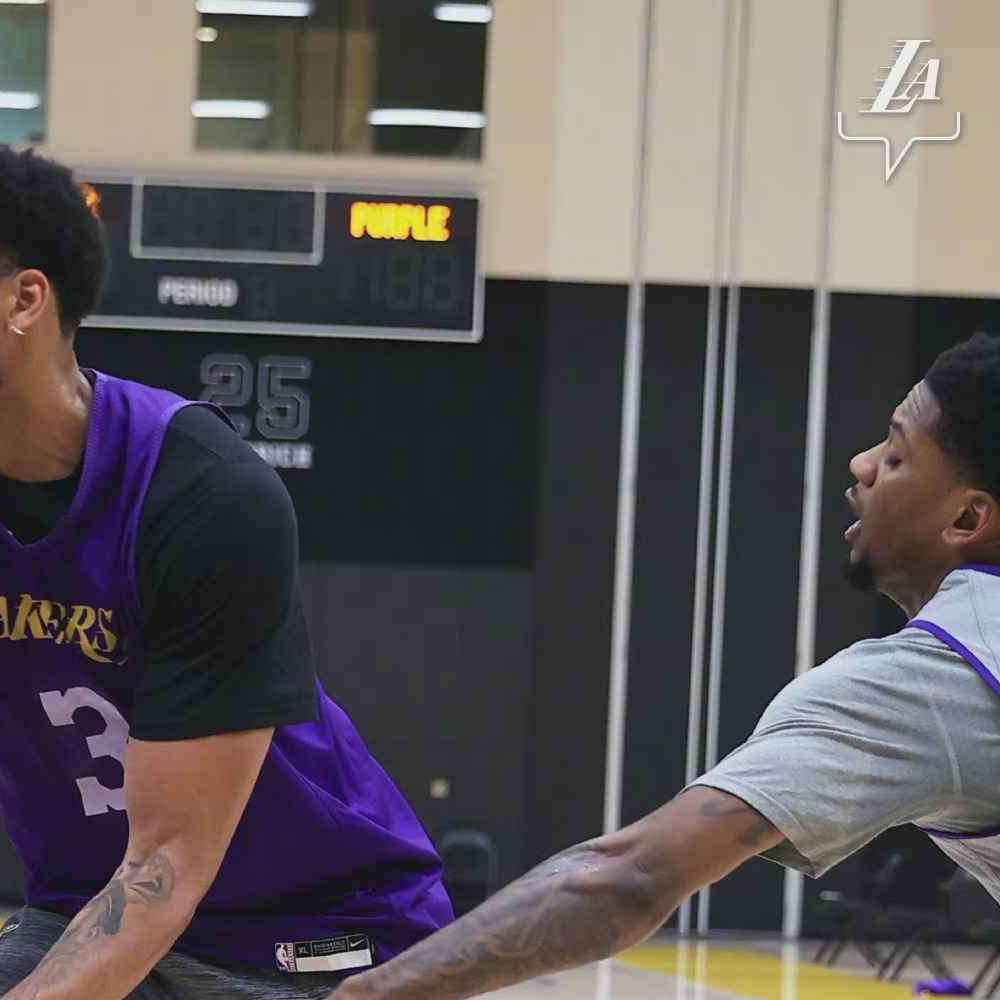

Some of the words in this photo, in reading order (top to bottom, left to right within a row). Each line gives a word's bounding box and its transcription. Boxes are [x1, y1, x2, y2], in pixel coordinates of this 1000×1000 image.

[350, 202, 450, 241] PURPLE
[158, 277, 238, 307] PERIOD
[200, 354, 312, 440] 25
[39, 687, 130, 816] 3
[298, 946, 309, 954] XL
